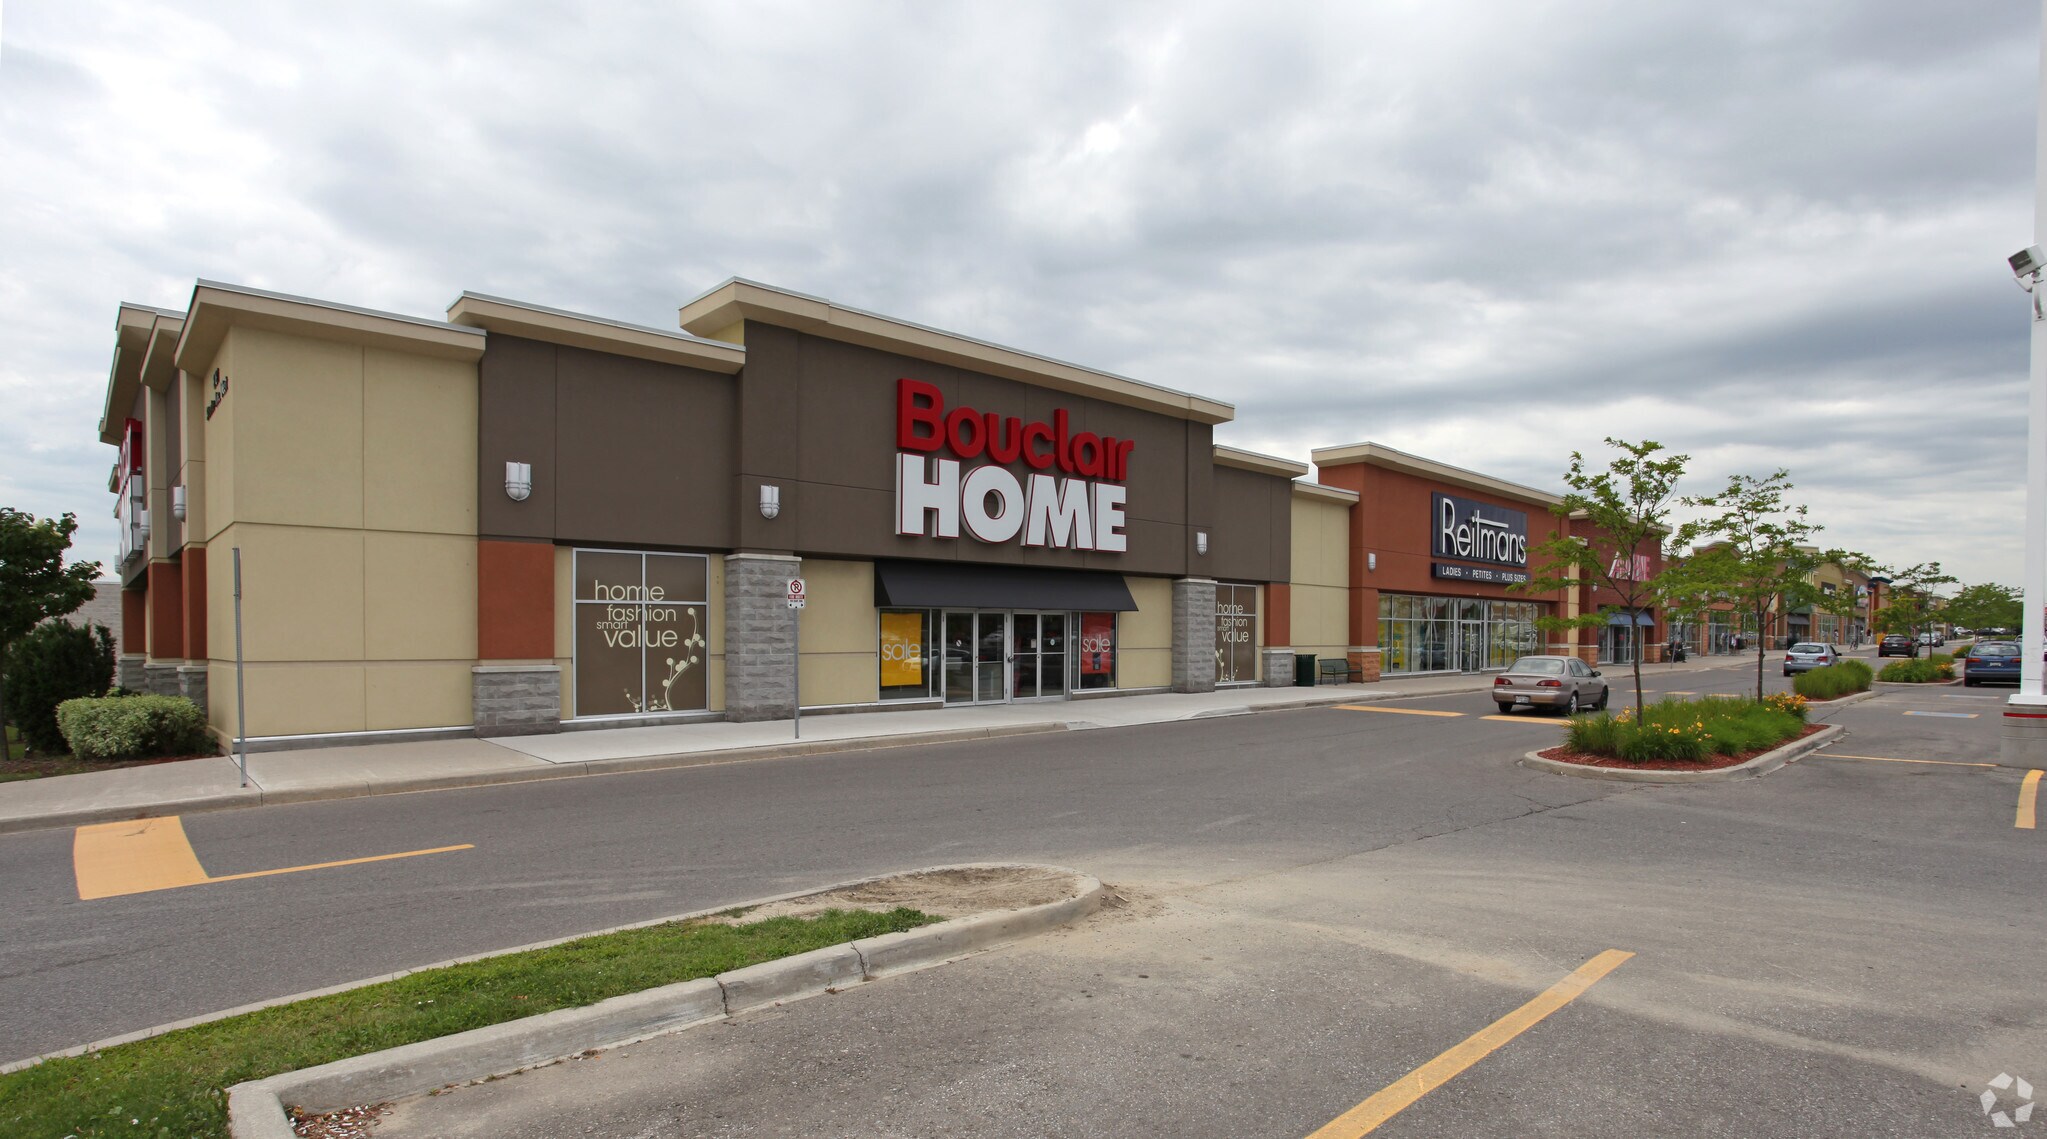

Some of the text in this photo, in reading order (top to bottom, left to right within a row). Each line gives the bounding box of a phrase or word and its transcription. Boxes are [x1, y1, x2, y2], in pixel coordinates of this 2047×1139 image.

[896, 378, 1134, 481] Bouclair
[895, 452, 1127, 552] HOME
[1442, 497, 1527, 564] Reitmans
[1442, 566, 1527, 583] LADIES PETITES PLUS SIZES
[594, 579, 665, 602] home
[606, 604, 677, 622] fashion
[1217, 601, 1244, 615] home
[596, 620, 629, 630] smart
[1221, 616, 1248, 627] fashion
[603, 624, 678, 648] value
[1082, 634, 1111, 653] sale
[1221, 628, 1249, 643] value
[882, 638, 921, 661] sale
